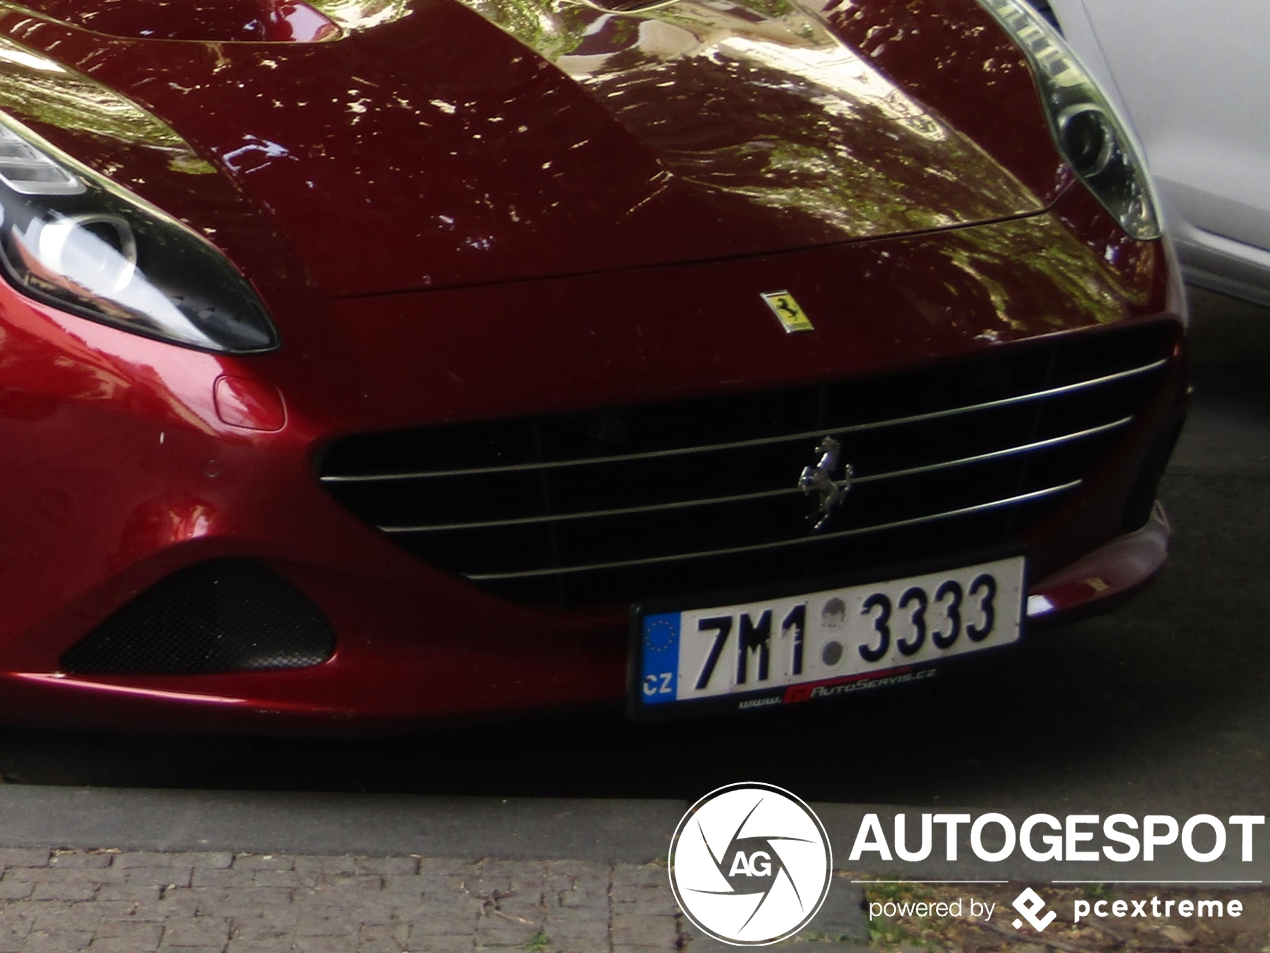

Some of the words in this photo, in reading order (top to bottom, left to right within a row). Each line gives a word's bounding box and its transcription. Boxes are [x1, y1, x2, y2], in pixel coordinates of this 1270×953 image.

[694, 603, 807, 690] 7M1
[858, 573, 997, 662] 3333
[643, 672, 673, 696] CZ
